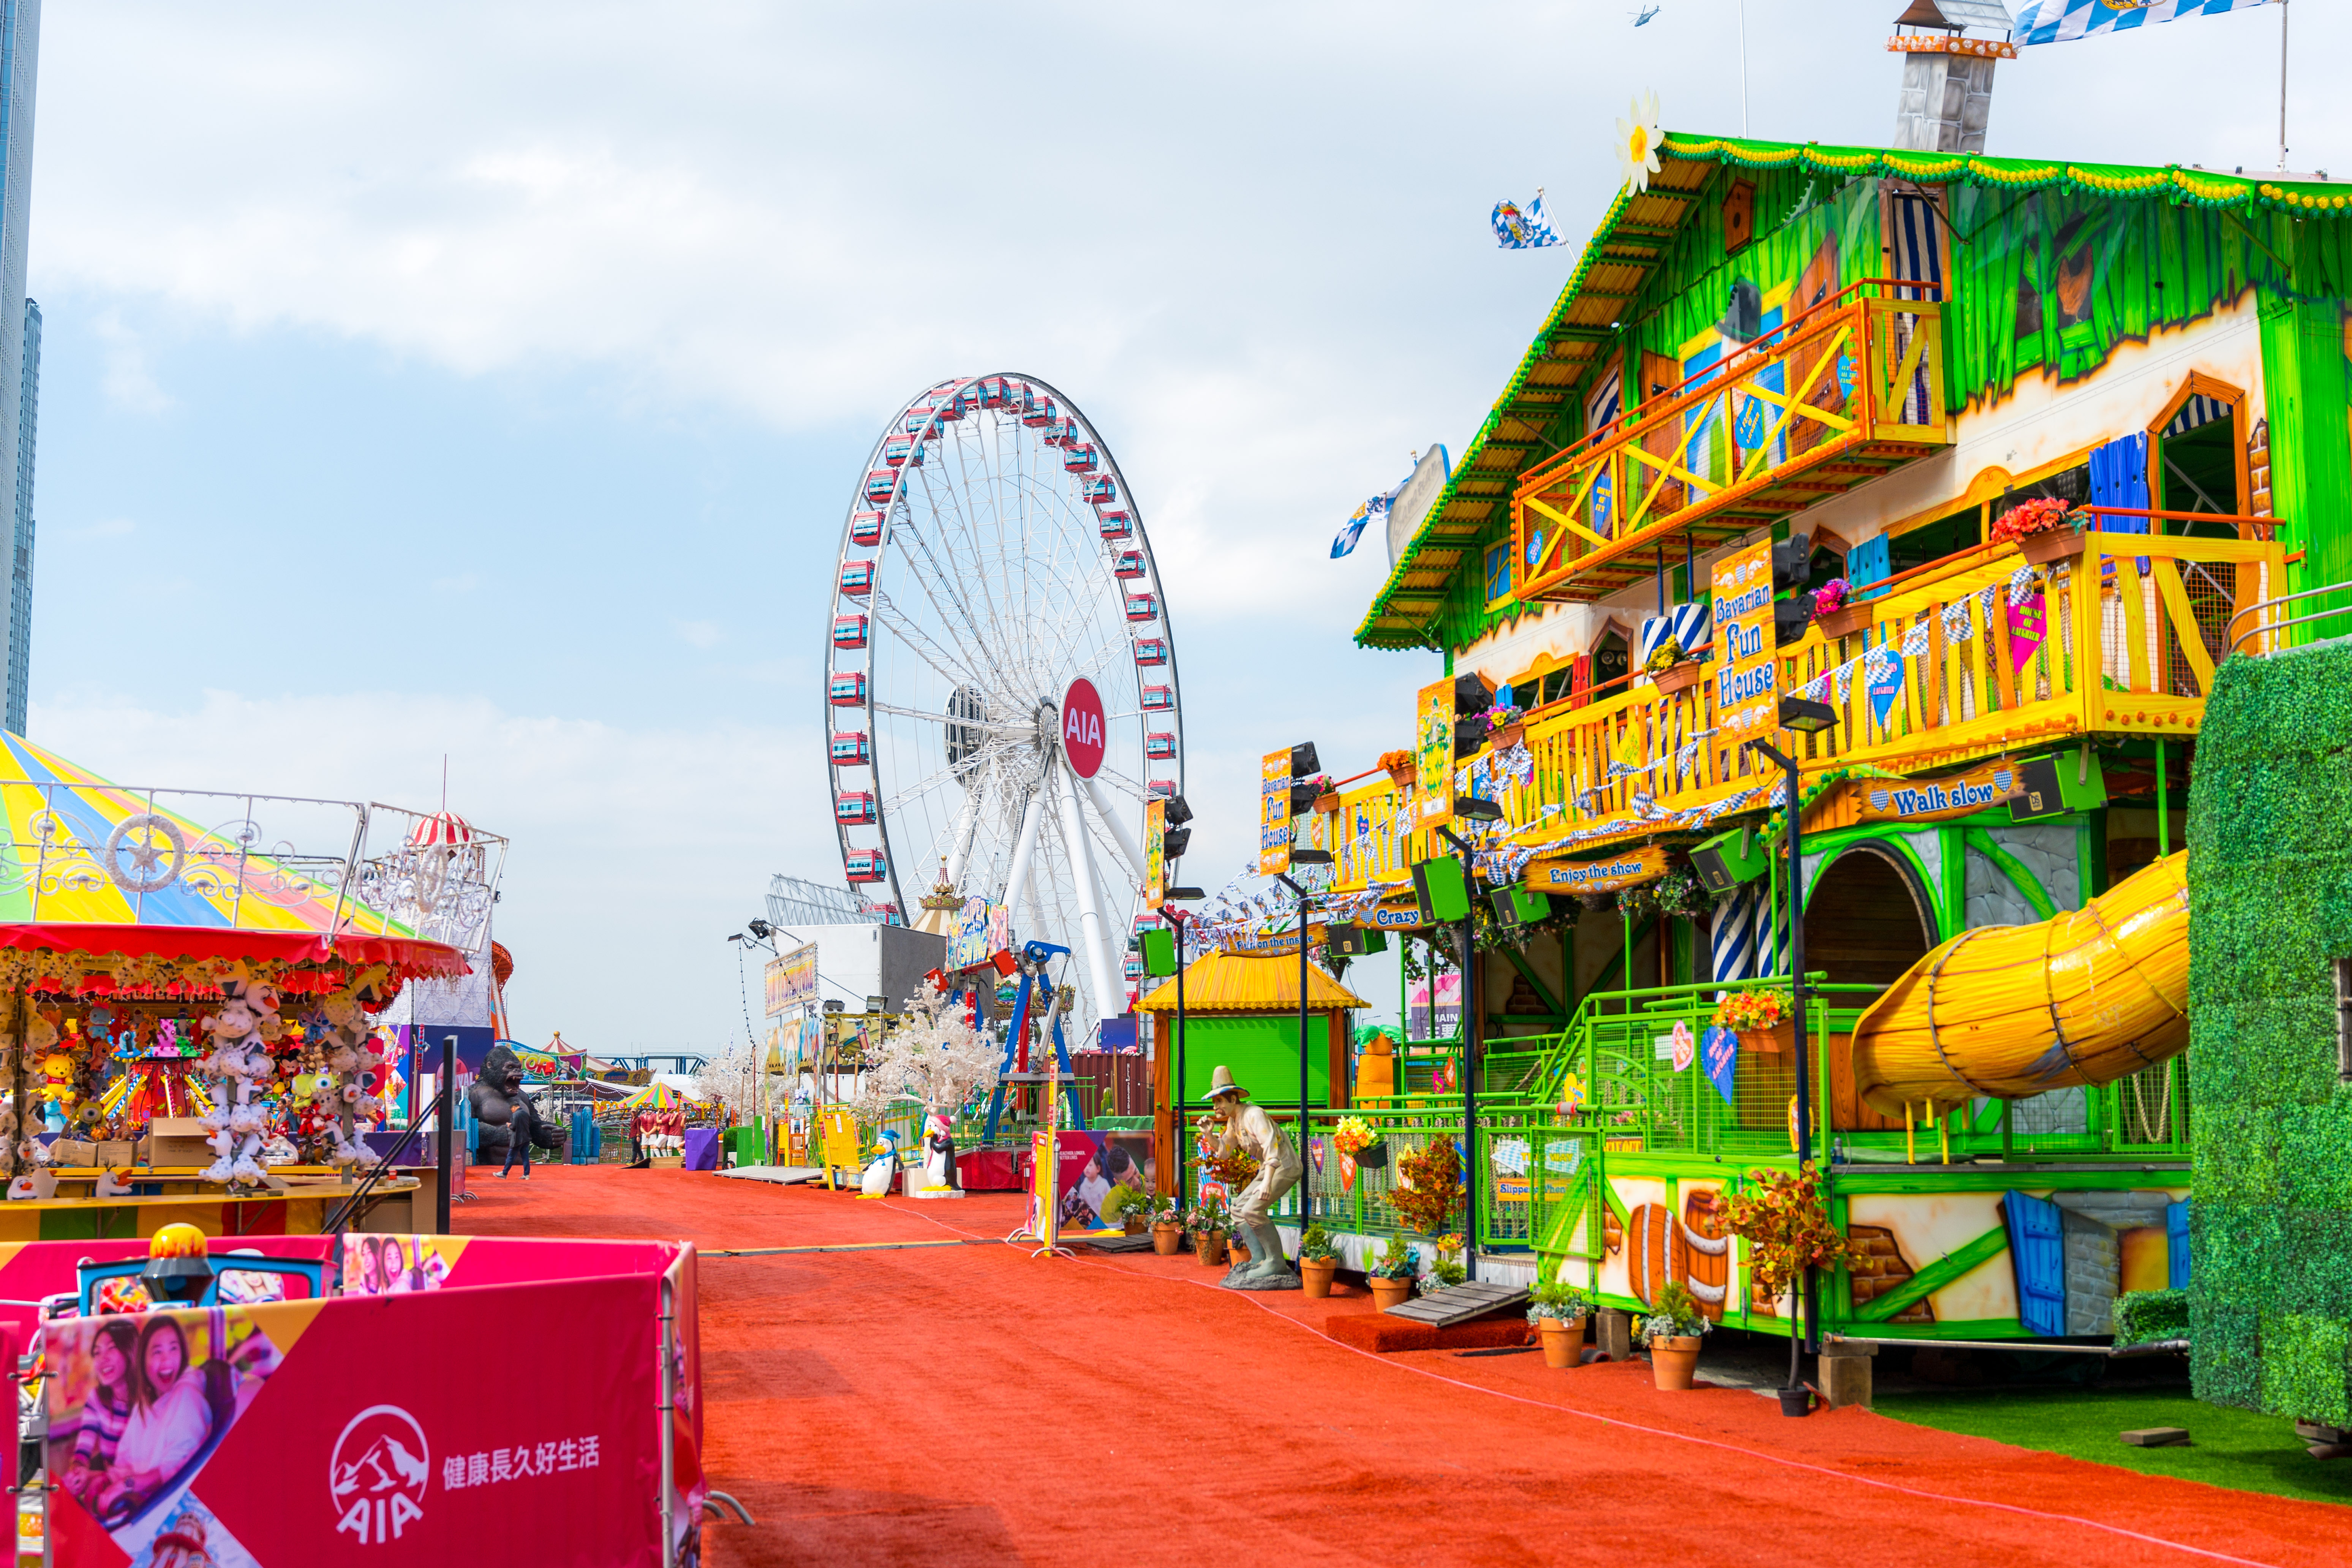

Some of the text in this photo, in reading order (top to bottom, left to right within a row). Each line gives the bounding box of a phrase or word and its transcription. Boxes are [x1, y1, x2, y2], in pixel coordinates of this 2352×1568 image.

[1714, 583, 1771, 624] Bavarian
[2018, 605, 2043, 620] HOUSE
[2011, 626, 2040, 642] LAUGHTER
[2023, 618, 2034, 628] OF
[1725, 621, 1762, 665] Fun
[1717, 661, 1775, 709] House
[1873, 686, 1895, 695] LAUGHTER
[1066, 707, 1102, 748] AIA
[1263, 775, 1289, 795] Bavarian
[1267, 796, 1284, 821] Fun
[1892, 779, 1994, 817] Walk slow
[2031, 795, 2040, 804] DS
[1261, 825, 1288, 850] House
[1549, 860, 1643, 884] Enjoy the show
[962, 897, 986, 932] SUPER
[1376, 909, 1420, 926] Crazy
[961, 929, 988, 965] SWING
[1270, 937, 1284, 947] the
[1286, 935, 1314, 945] inse
[1549, 1153, 1573, 1162] WAY
[443, 1435, 600, 1491] 健康長久好生活
[335, 1491, 424, 1544] AIA
